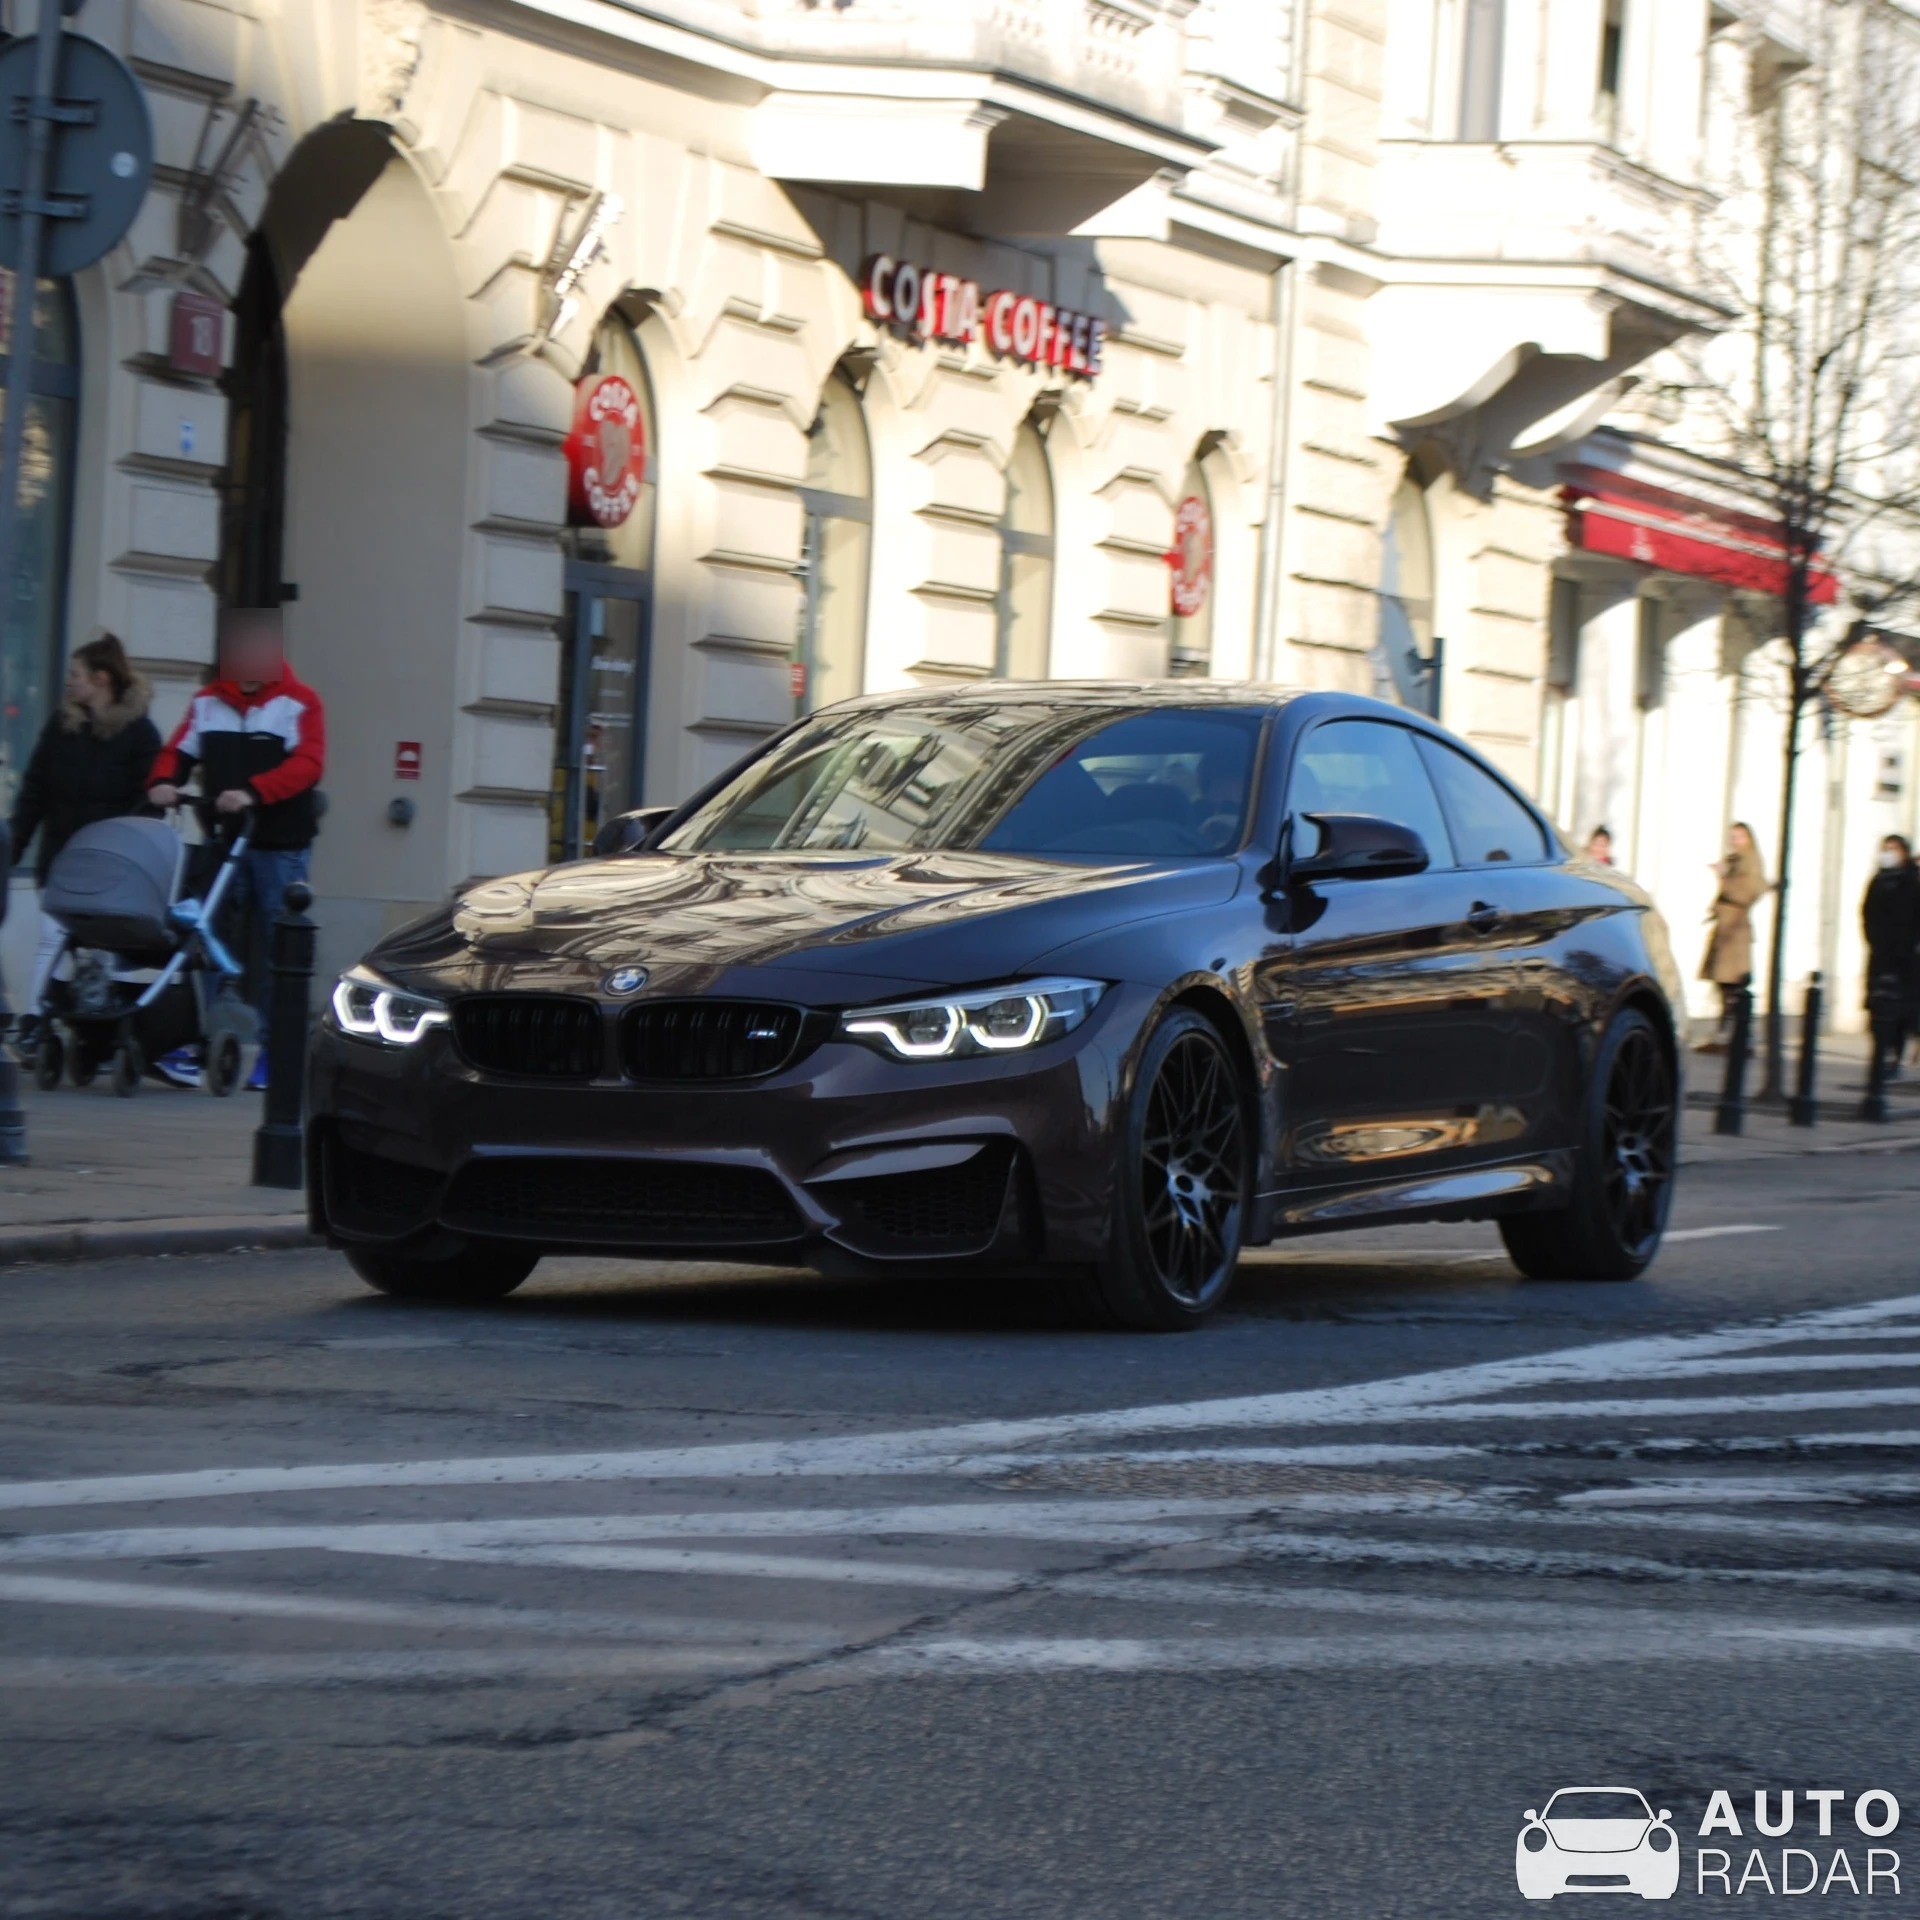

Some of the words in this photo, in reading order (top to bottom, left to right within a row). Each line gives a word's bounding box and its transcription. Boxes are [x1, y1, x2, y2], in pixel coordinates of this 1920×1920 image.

[867, 254, 979, 340] COSTA
[990, 291, 1106, 374] COFFEE
[590, 381, 637, 429] COSTA
[583, 466, 640, 522] COFFEE
